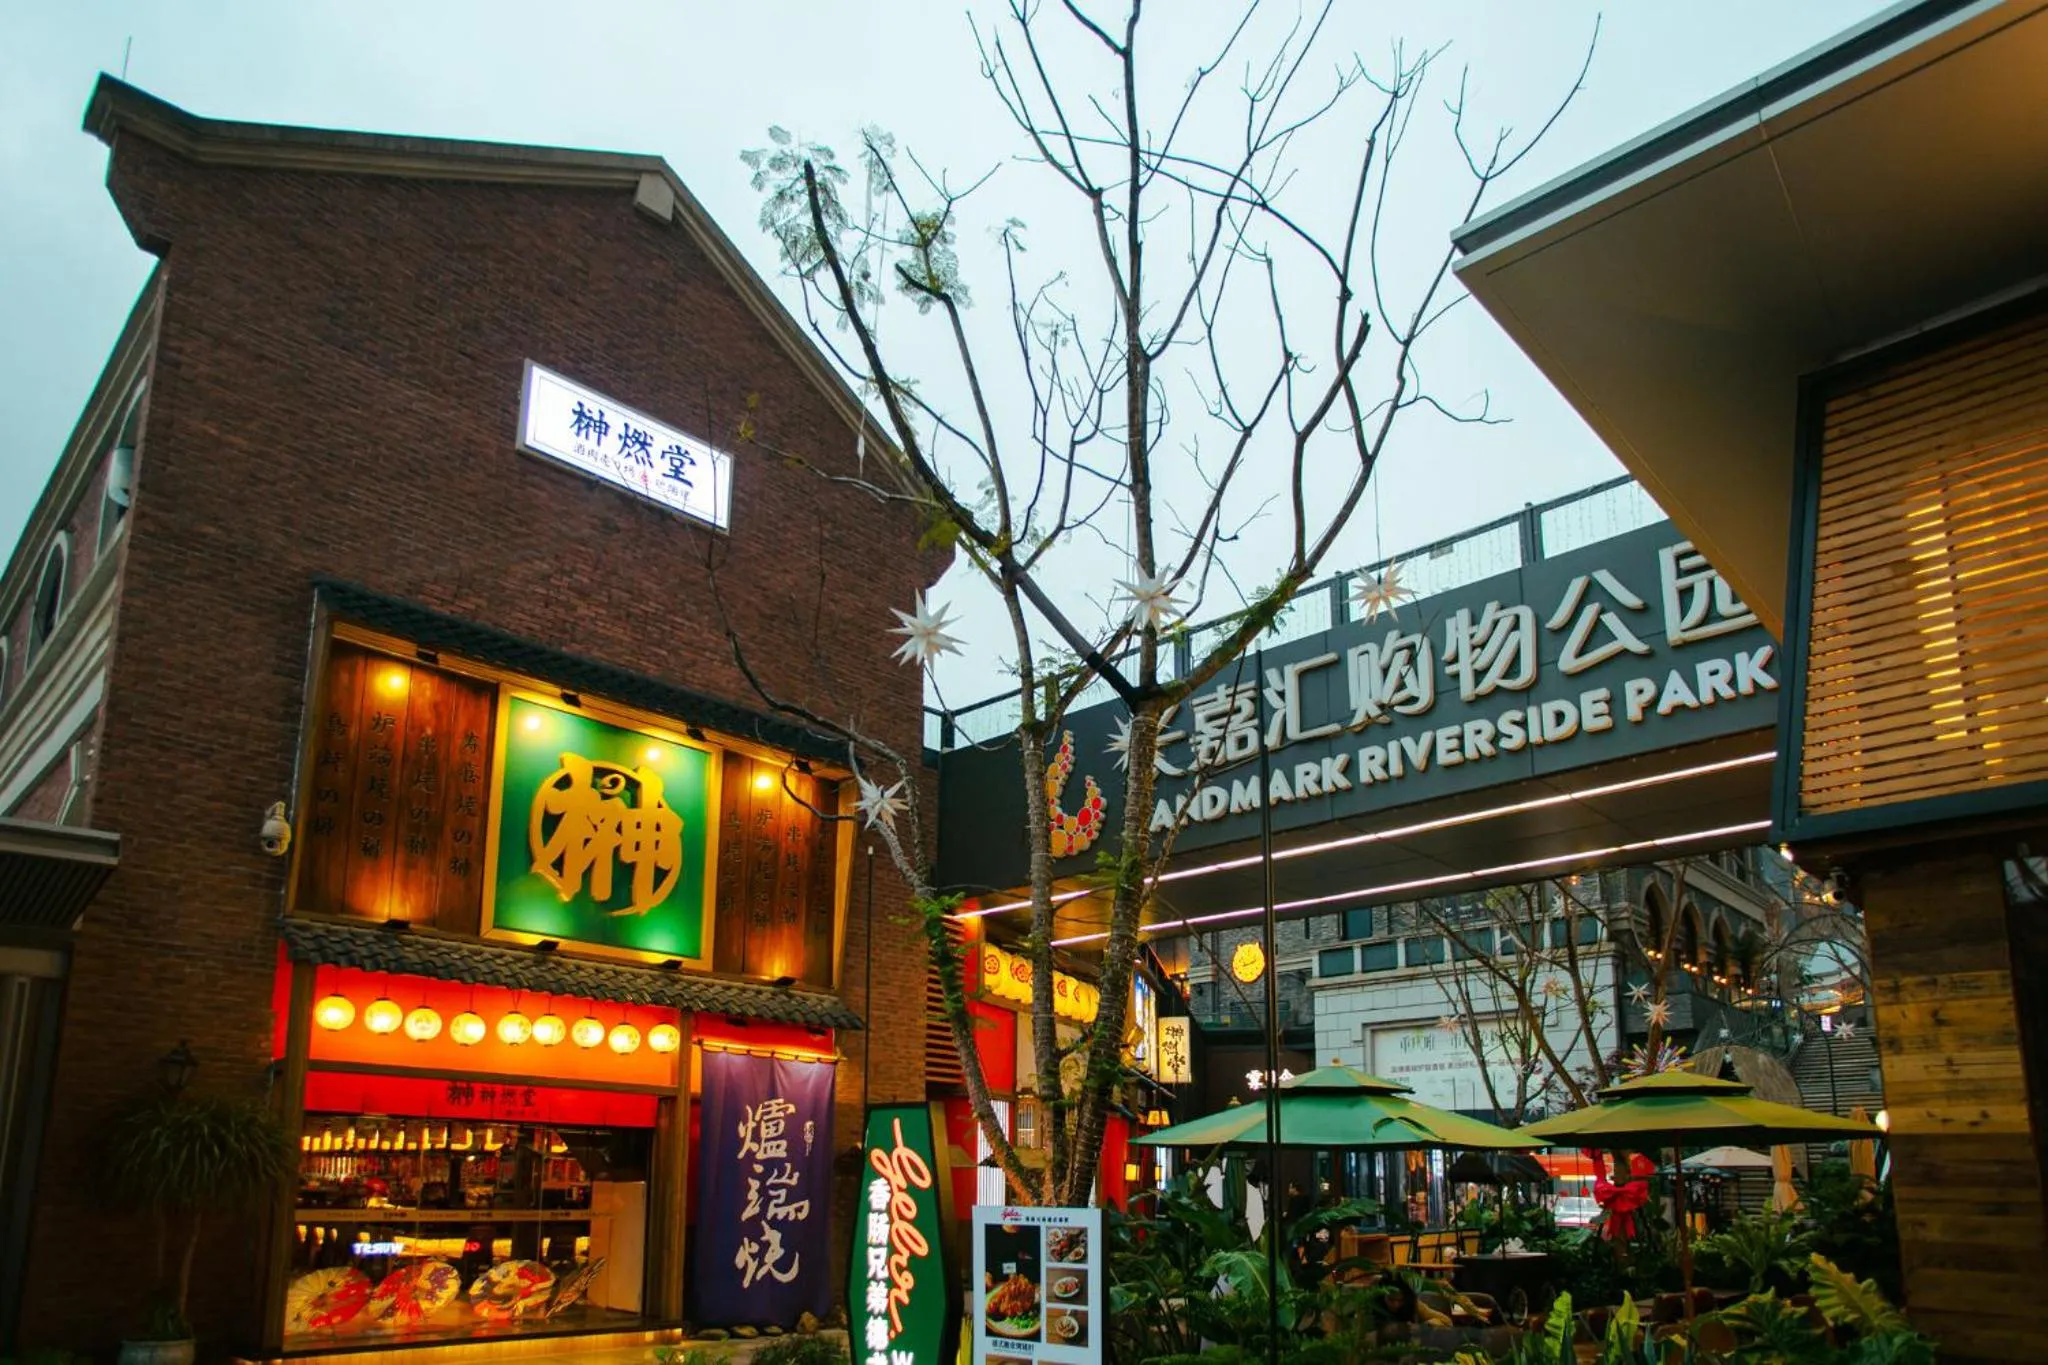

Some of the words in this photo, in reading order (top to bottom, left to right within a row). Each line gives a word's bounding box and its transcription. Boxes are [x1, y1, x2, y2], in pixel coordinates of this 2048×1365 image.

[1149, 753, 1352, 833] ANDMARK
[1358, 687, 1613, 784] RIVERSIDE
[1625, 645, 1779, 723] PARK
